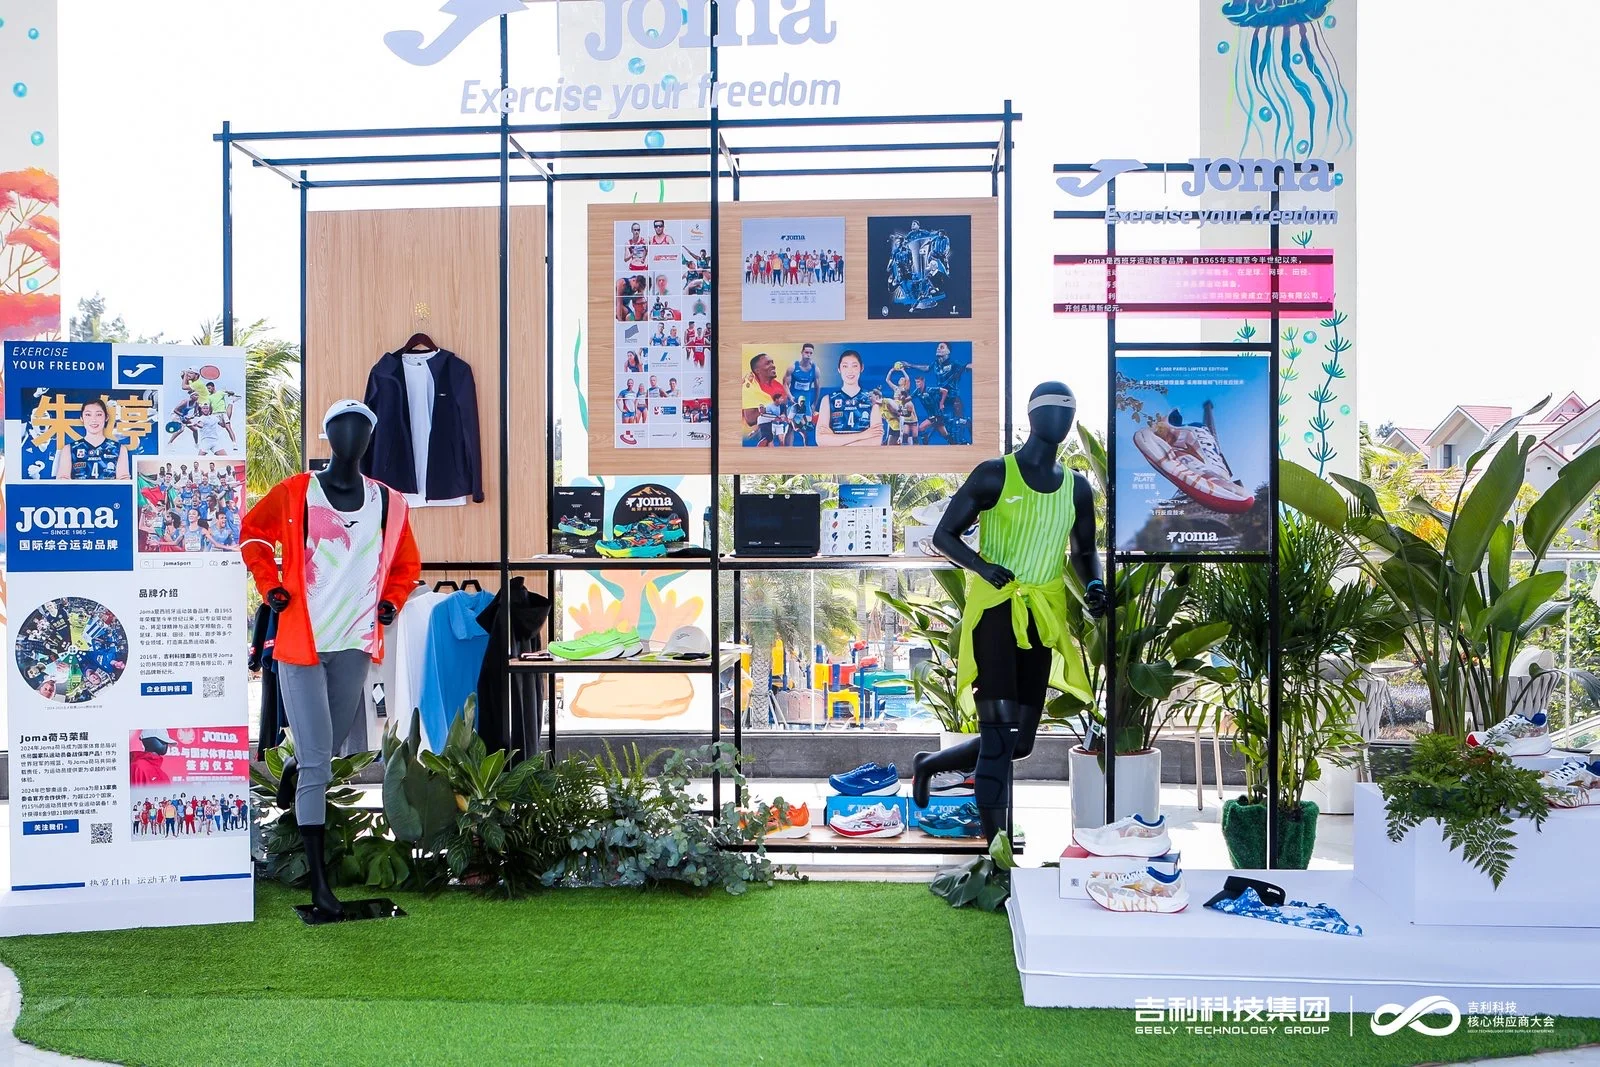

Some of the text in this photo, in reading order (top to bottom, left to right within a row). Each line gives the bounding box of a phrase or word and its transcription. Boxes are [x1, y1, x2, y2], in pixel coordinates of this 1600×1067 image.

[460, 72, 842, 119] Exercise your freedom
[1104, 205, 1338, 228] Exercise your freedom
[12, 346, 68, 357] EXERCISE
[12, 360, 105, 371] YOUR FREEDOM
[32, 394, 153, 451] 朱婷
[848, 412, 854, 428] 4
[92, 462, 99, 478] 4
[20, 540, 118, 551] 国际综合运动品牌
[139, 588, 178, 598] 品牌介绍
[20, 732, 89, 744] Joma荷马荣耀
[186, 760, 234, 771] 签约仪式
